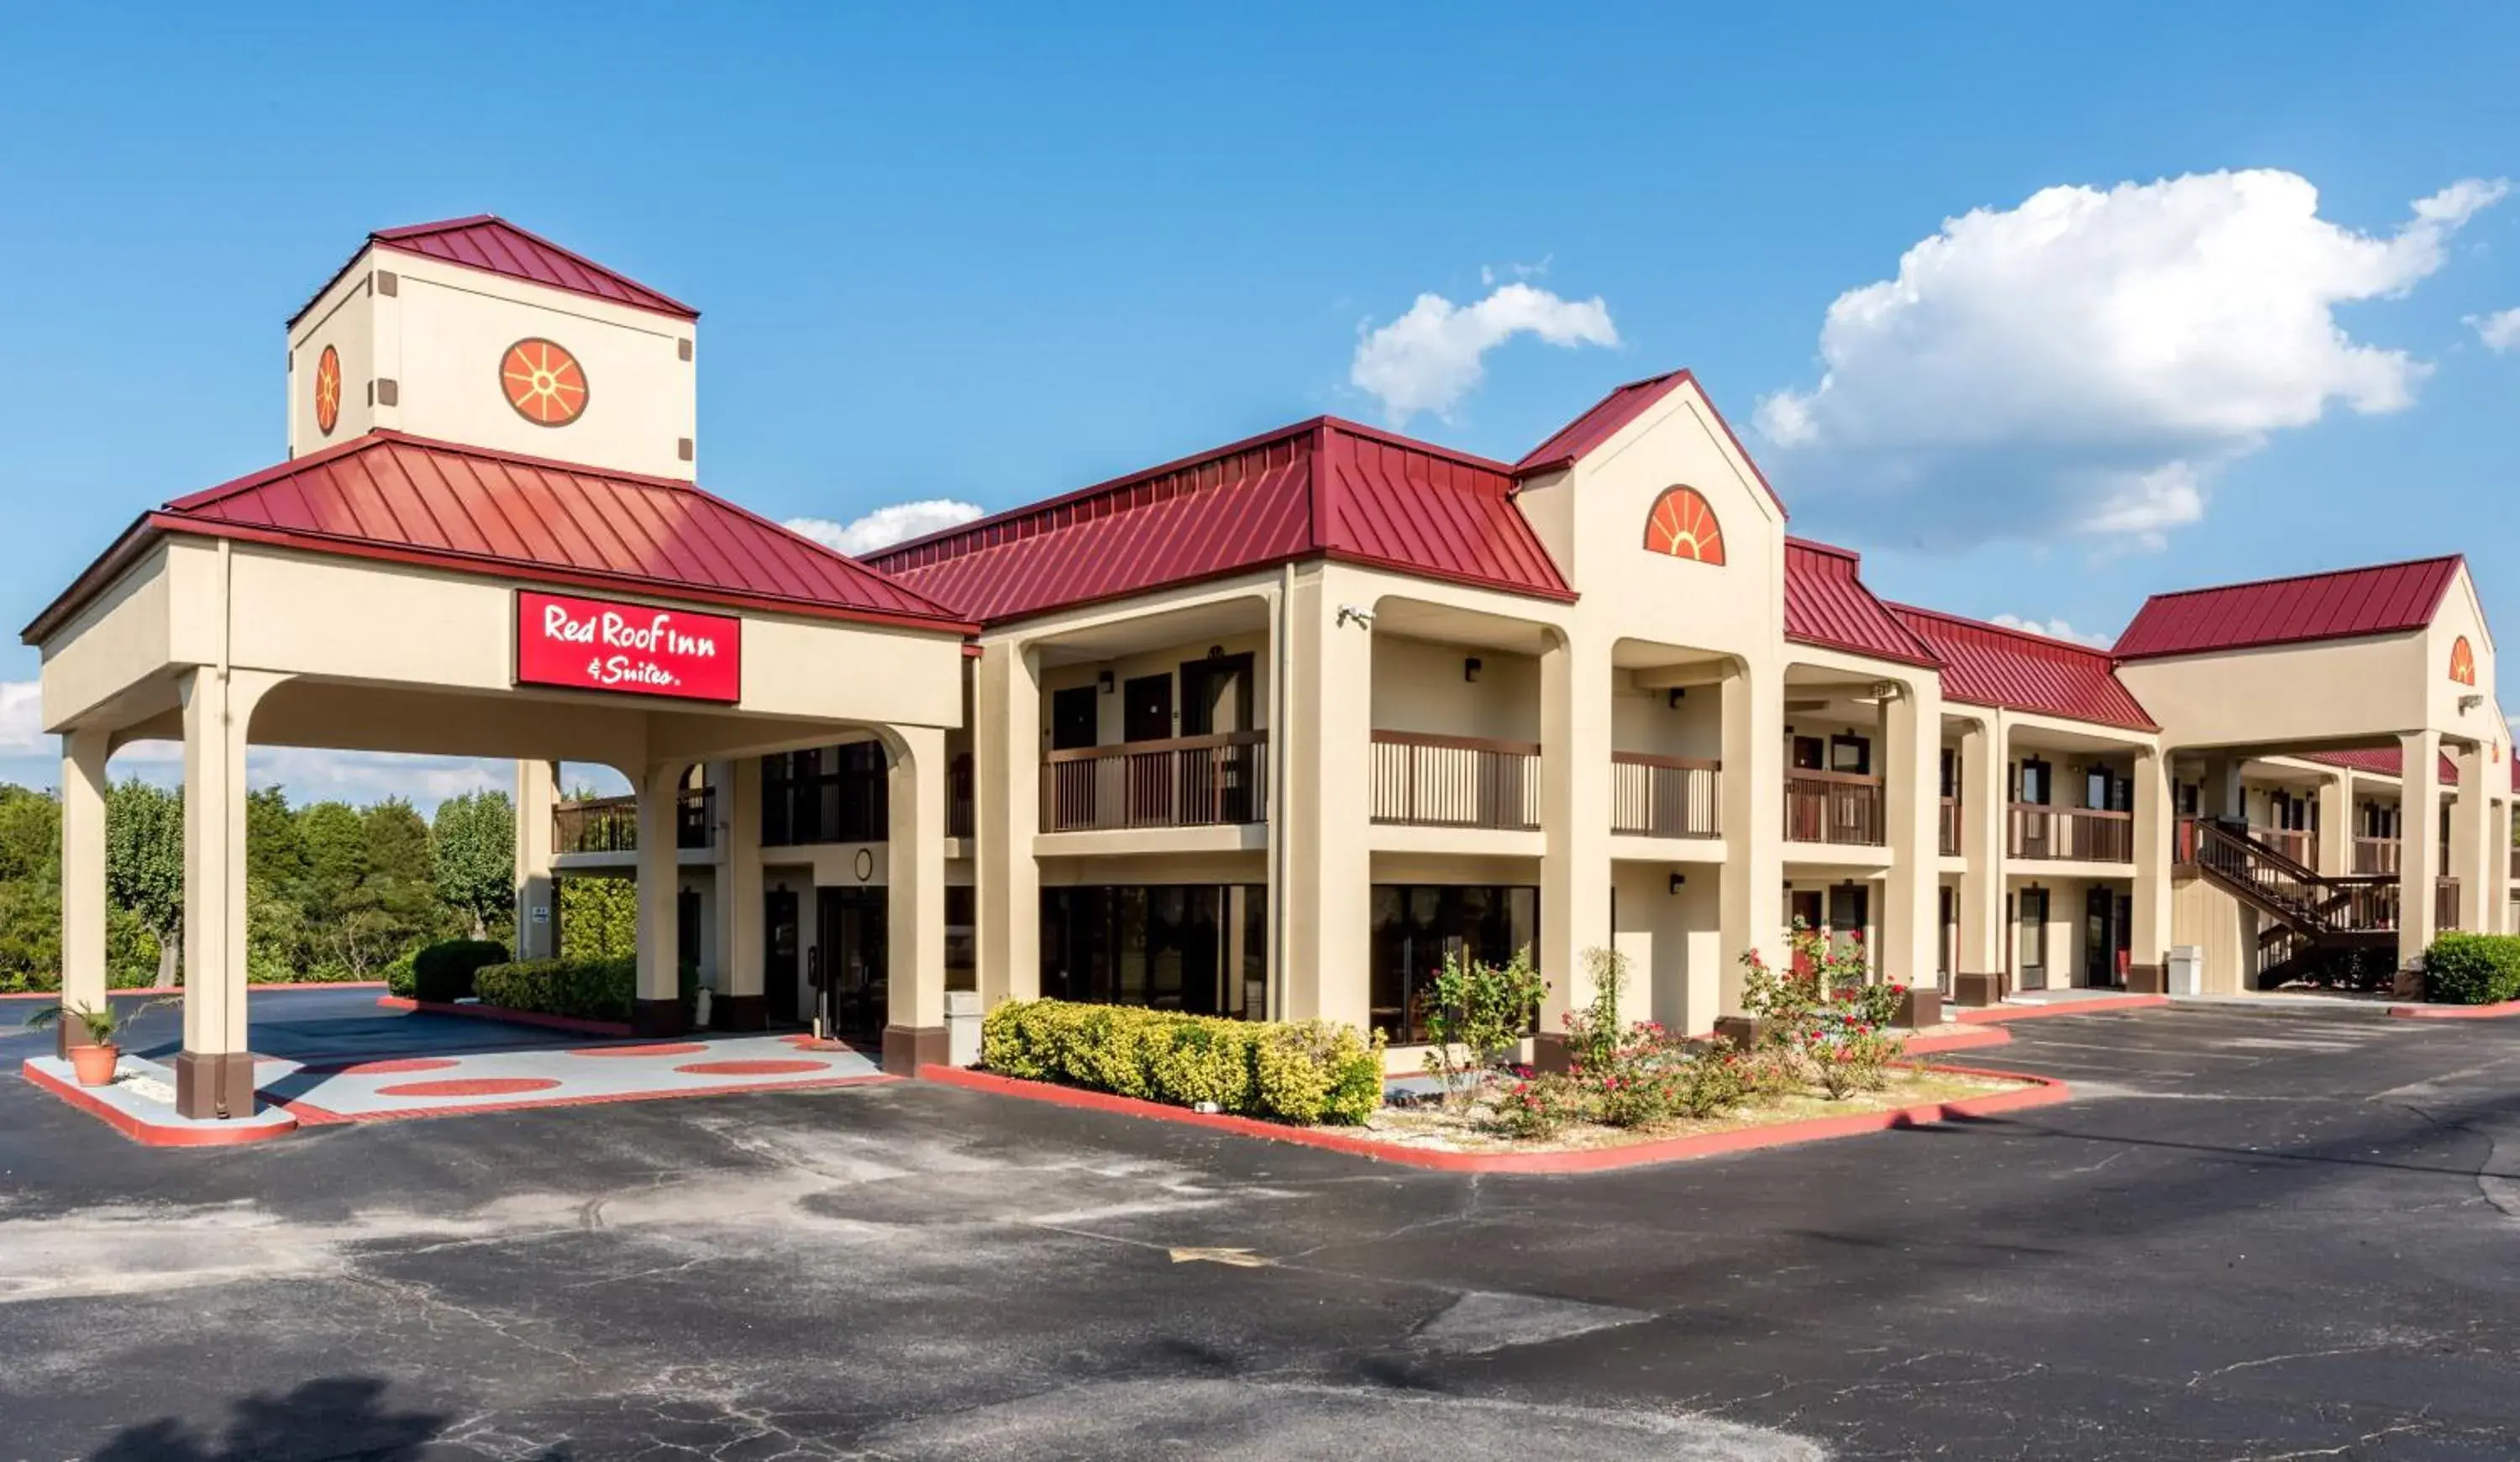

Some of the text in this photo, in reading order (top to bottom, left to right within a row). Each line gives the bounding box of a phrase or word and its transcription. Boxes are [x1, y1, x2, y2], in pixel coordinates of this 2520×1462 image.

[544, 604, 716, 657] Red Roof Inn
[587, 655, 675, 686] & Suites
